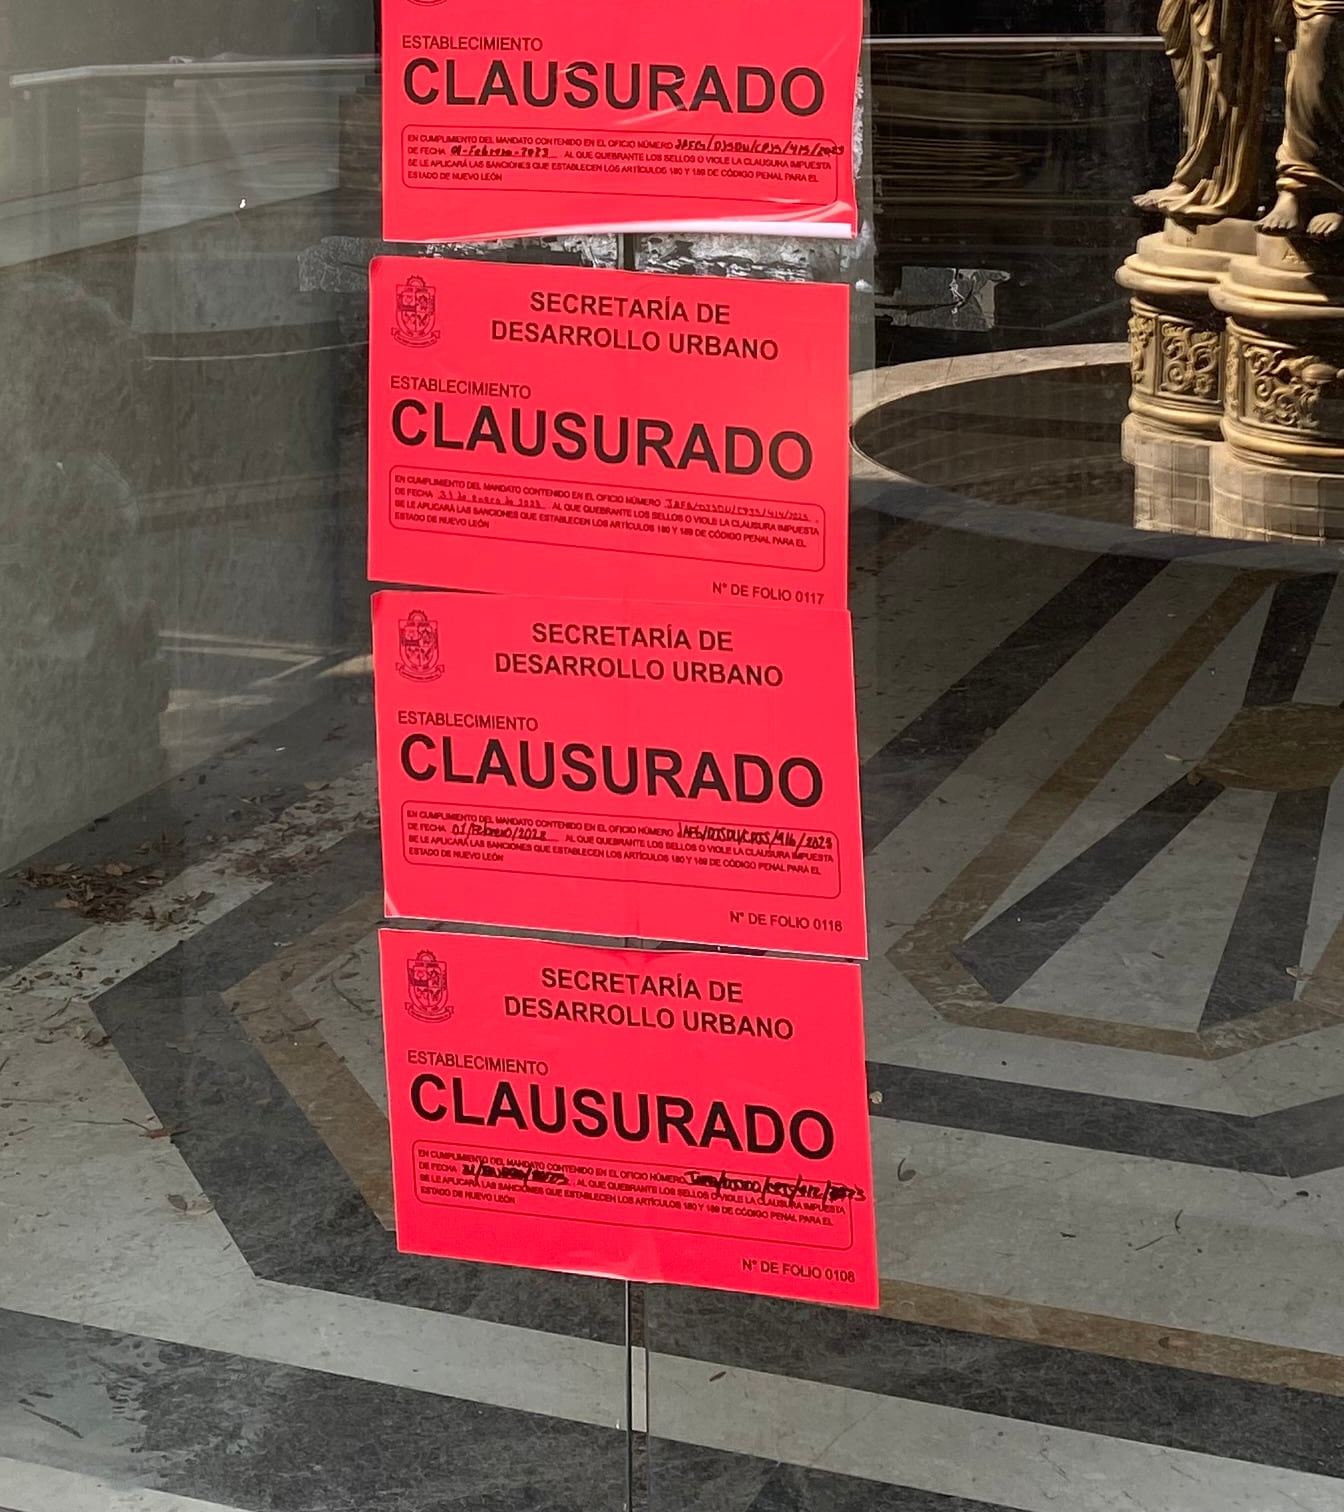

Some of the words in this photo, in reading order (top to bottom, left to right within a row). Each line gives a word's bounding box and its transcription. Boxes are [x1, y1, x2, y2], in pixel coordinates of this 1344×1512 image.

[402, 34, 543, 51] ESTABLECIMIENTO
[403, 57, 824, 117] CLAUSURADO
[530, 291, 688, 322] SECRETARÍA
[697, 302, 729, 325] DE
[491, 319, 660, 352] DESARROLLO
[669, 332, 778, 360] URBANO
[390, 375, 531, 399] ESTABLECIMIENTO
[391, 398, 813, 481] CLAUSURADO
[730, 583, 749, 597] DE
[752, 585, 792, 601] FOLIO
[794, 590, 824, 605] 0117
[532, 622, 691, 649] SECRETARÍA
[698, 629, 733, 652] DE
[495, 652, 664, 680] DESARROLLO
[672, 661, 783, 687] URBANO
[397, 710, 538, 731] ESTABLECIMIENTO
[400, 733, 823, 808] CLAUSURADO
[748, 912, 766, 925] DE
[769, 914, 810, 929] FOLIO
[541, 967, 701, 1000] SECRETARÍA
[709, 980, 742, 1003] DE
[504, 995, 674, 1029] DESARROLLO
[682, 1010, 793, 1040] URBANO
[407, 1049, 548, 1076] ESTABLECIMIENTO
[410, 1073, 834, 1160] CLAUSURADO
[760, 1260, 779, 1274] DE
[782, 1262, 822, 1279] FOLIO
[824, 1267, 855, 1283] 0108
